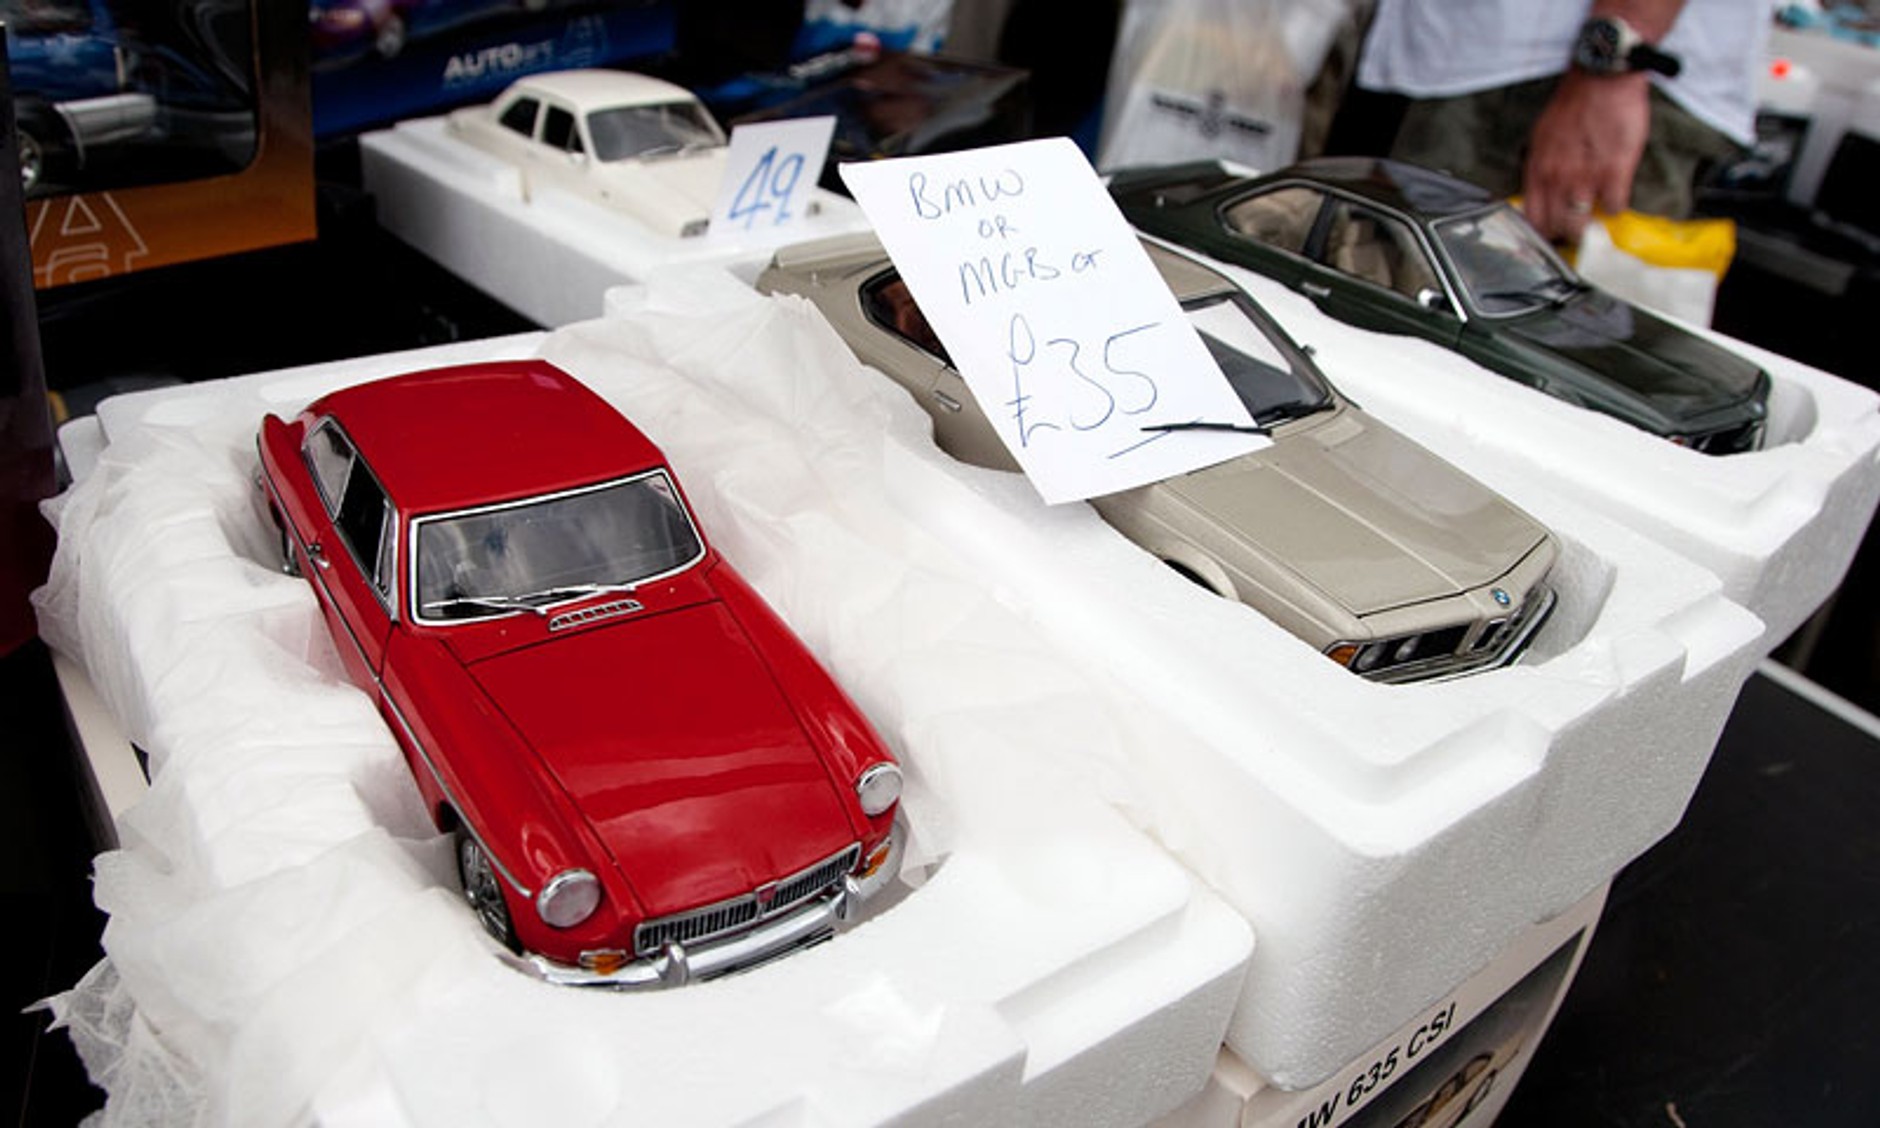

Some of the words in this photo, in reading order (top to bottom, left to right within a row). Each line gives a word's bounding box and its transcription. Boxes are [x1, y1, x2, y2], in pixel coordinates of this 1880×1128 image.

[728, 145, 806, 230] 49
[909, 169, 1024, 219] BMW
[978, 214, 1019, 238] OR
[959, 247, 1061, 304] MGB
[1005, 312, 1162, 448] £35
[1297, 1090, 1341, 1128] W
[1346, 1046, 1400, 1106] 635
[1406, 1001, 1457, 1058] CSI
